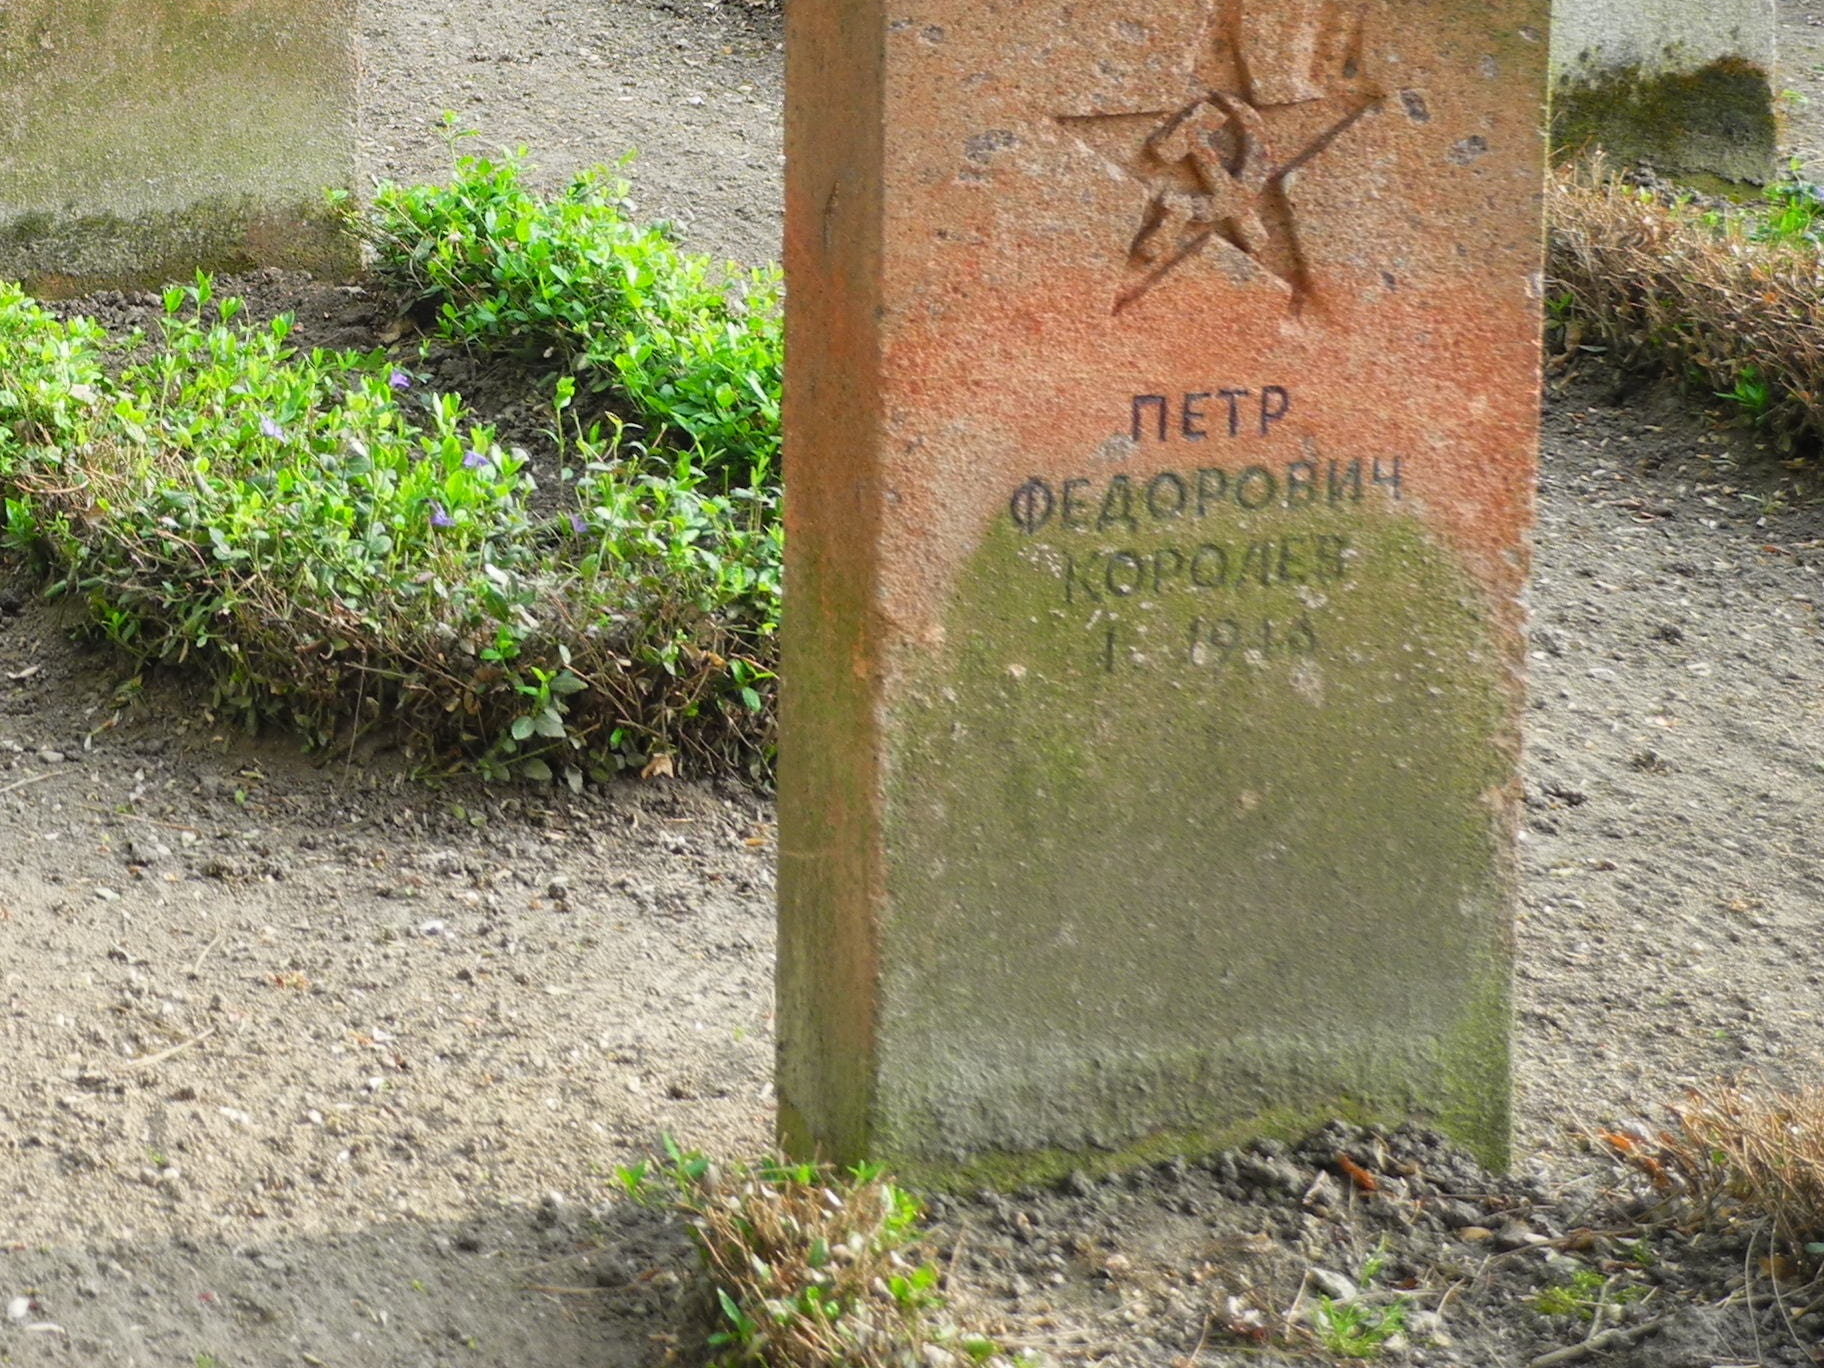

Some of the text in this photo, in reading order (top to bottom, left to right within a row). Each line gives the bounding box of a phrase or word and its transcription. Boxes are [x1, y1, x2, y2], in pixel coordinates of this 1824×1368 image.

[1130, 385, 1290, 442] ПЕТР
[1009, 455, 1404, 536] ФЕДОРОВИЧ
[1065, 533, 1348, 605] КОРОЛЕВ
